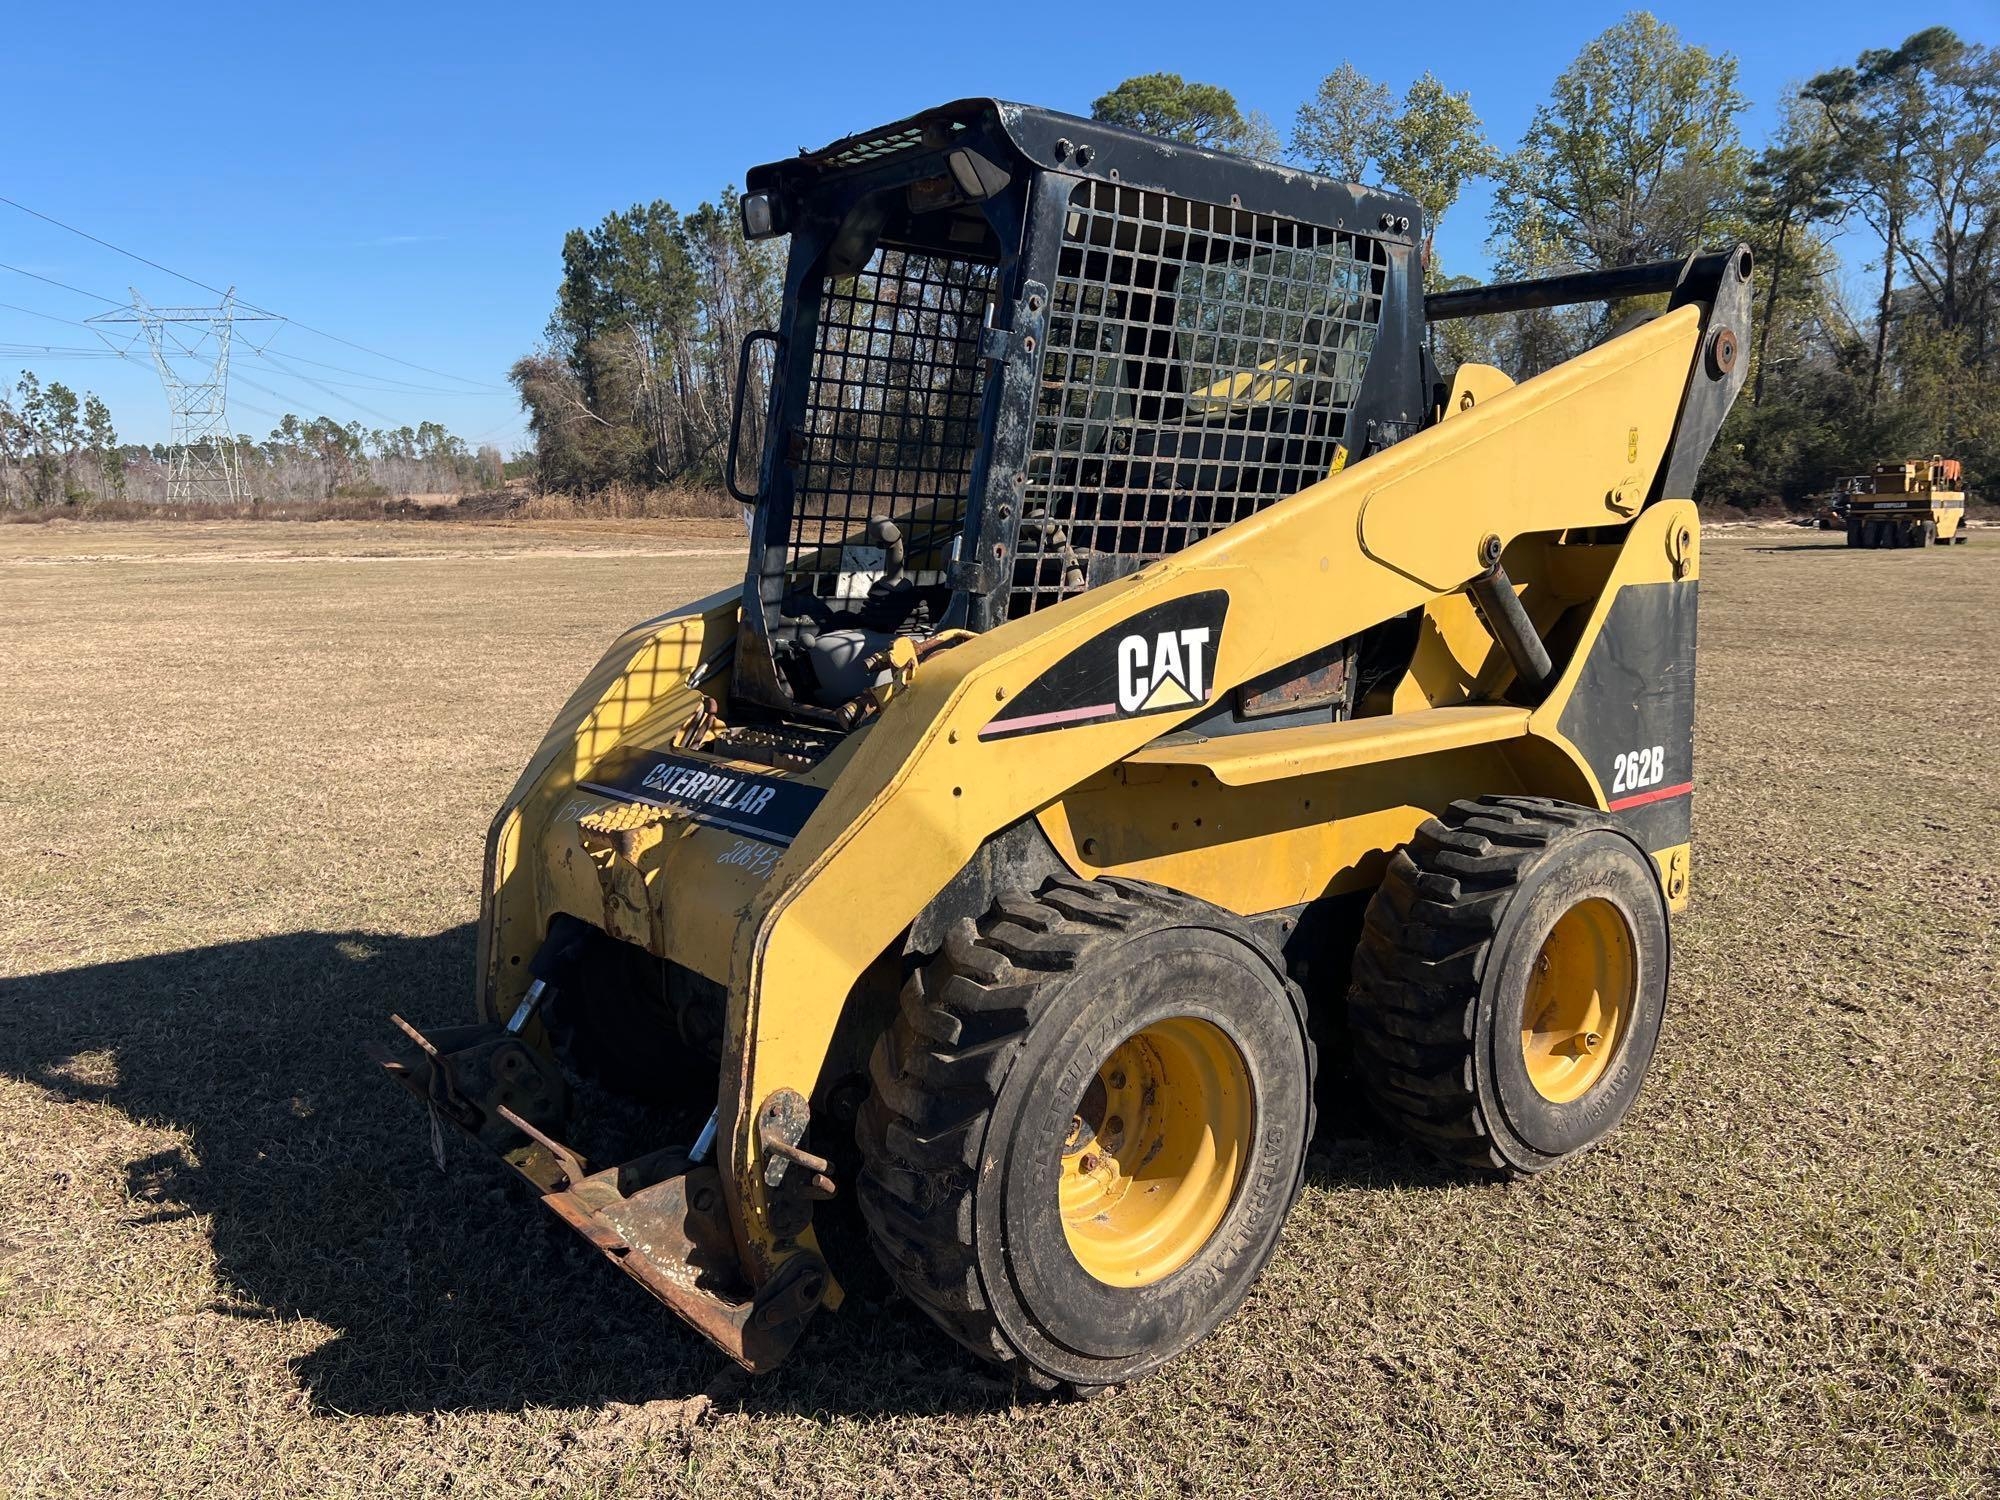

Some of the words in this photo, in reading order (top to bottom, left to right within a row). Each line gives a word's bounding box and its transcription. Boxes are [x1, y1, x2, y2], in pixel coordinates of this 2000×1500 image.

[1117, 626, 1210, 712] CAT
[641, 762, 777, 816] CATERPILLAR
[1612, 745, 1665, 794] 262B
[1197, 1122, 1287, 1292] CATERPILLAR
